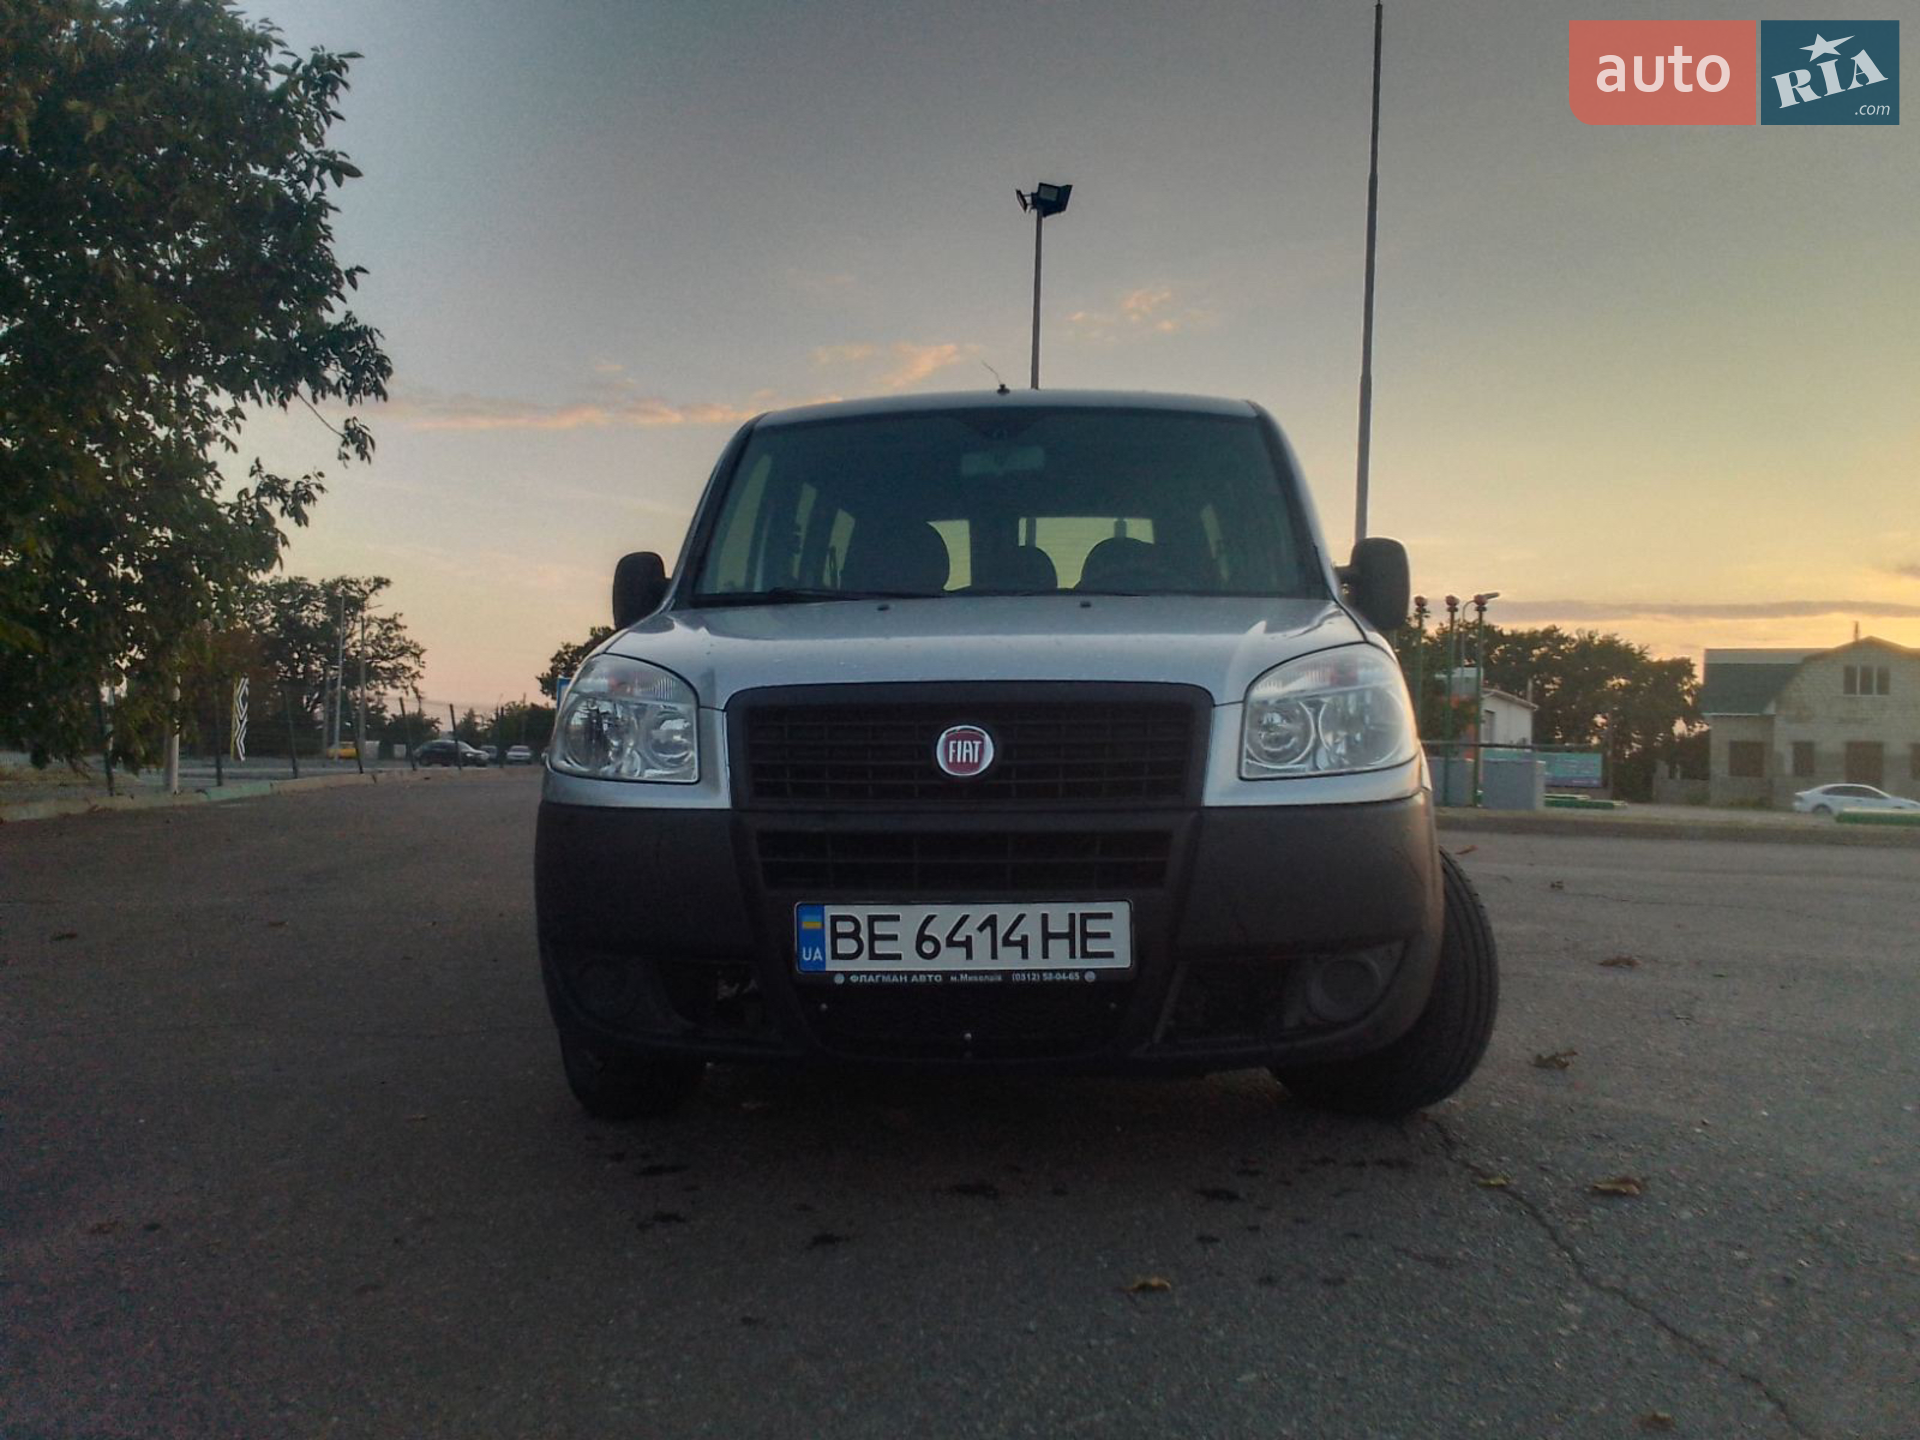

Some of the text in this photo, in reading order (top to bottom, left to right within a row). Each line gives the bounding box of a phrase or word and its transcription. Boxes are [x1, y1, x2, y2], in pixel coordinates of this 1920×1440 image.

[948, 740, 982, 763] FIAT
[830, 911, 1115, 961] BE 6414 HE
[802, 946, 823, 961] UA
